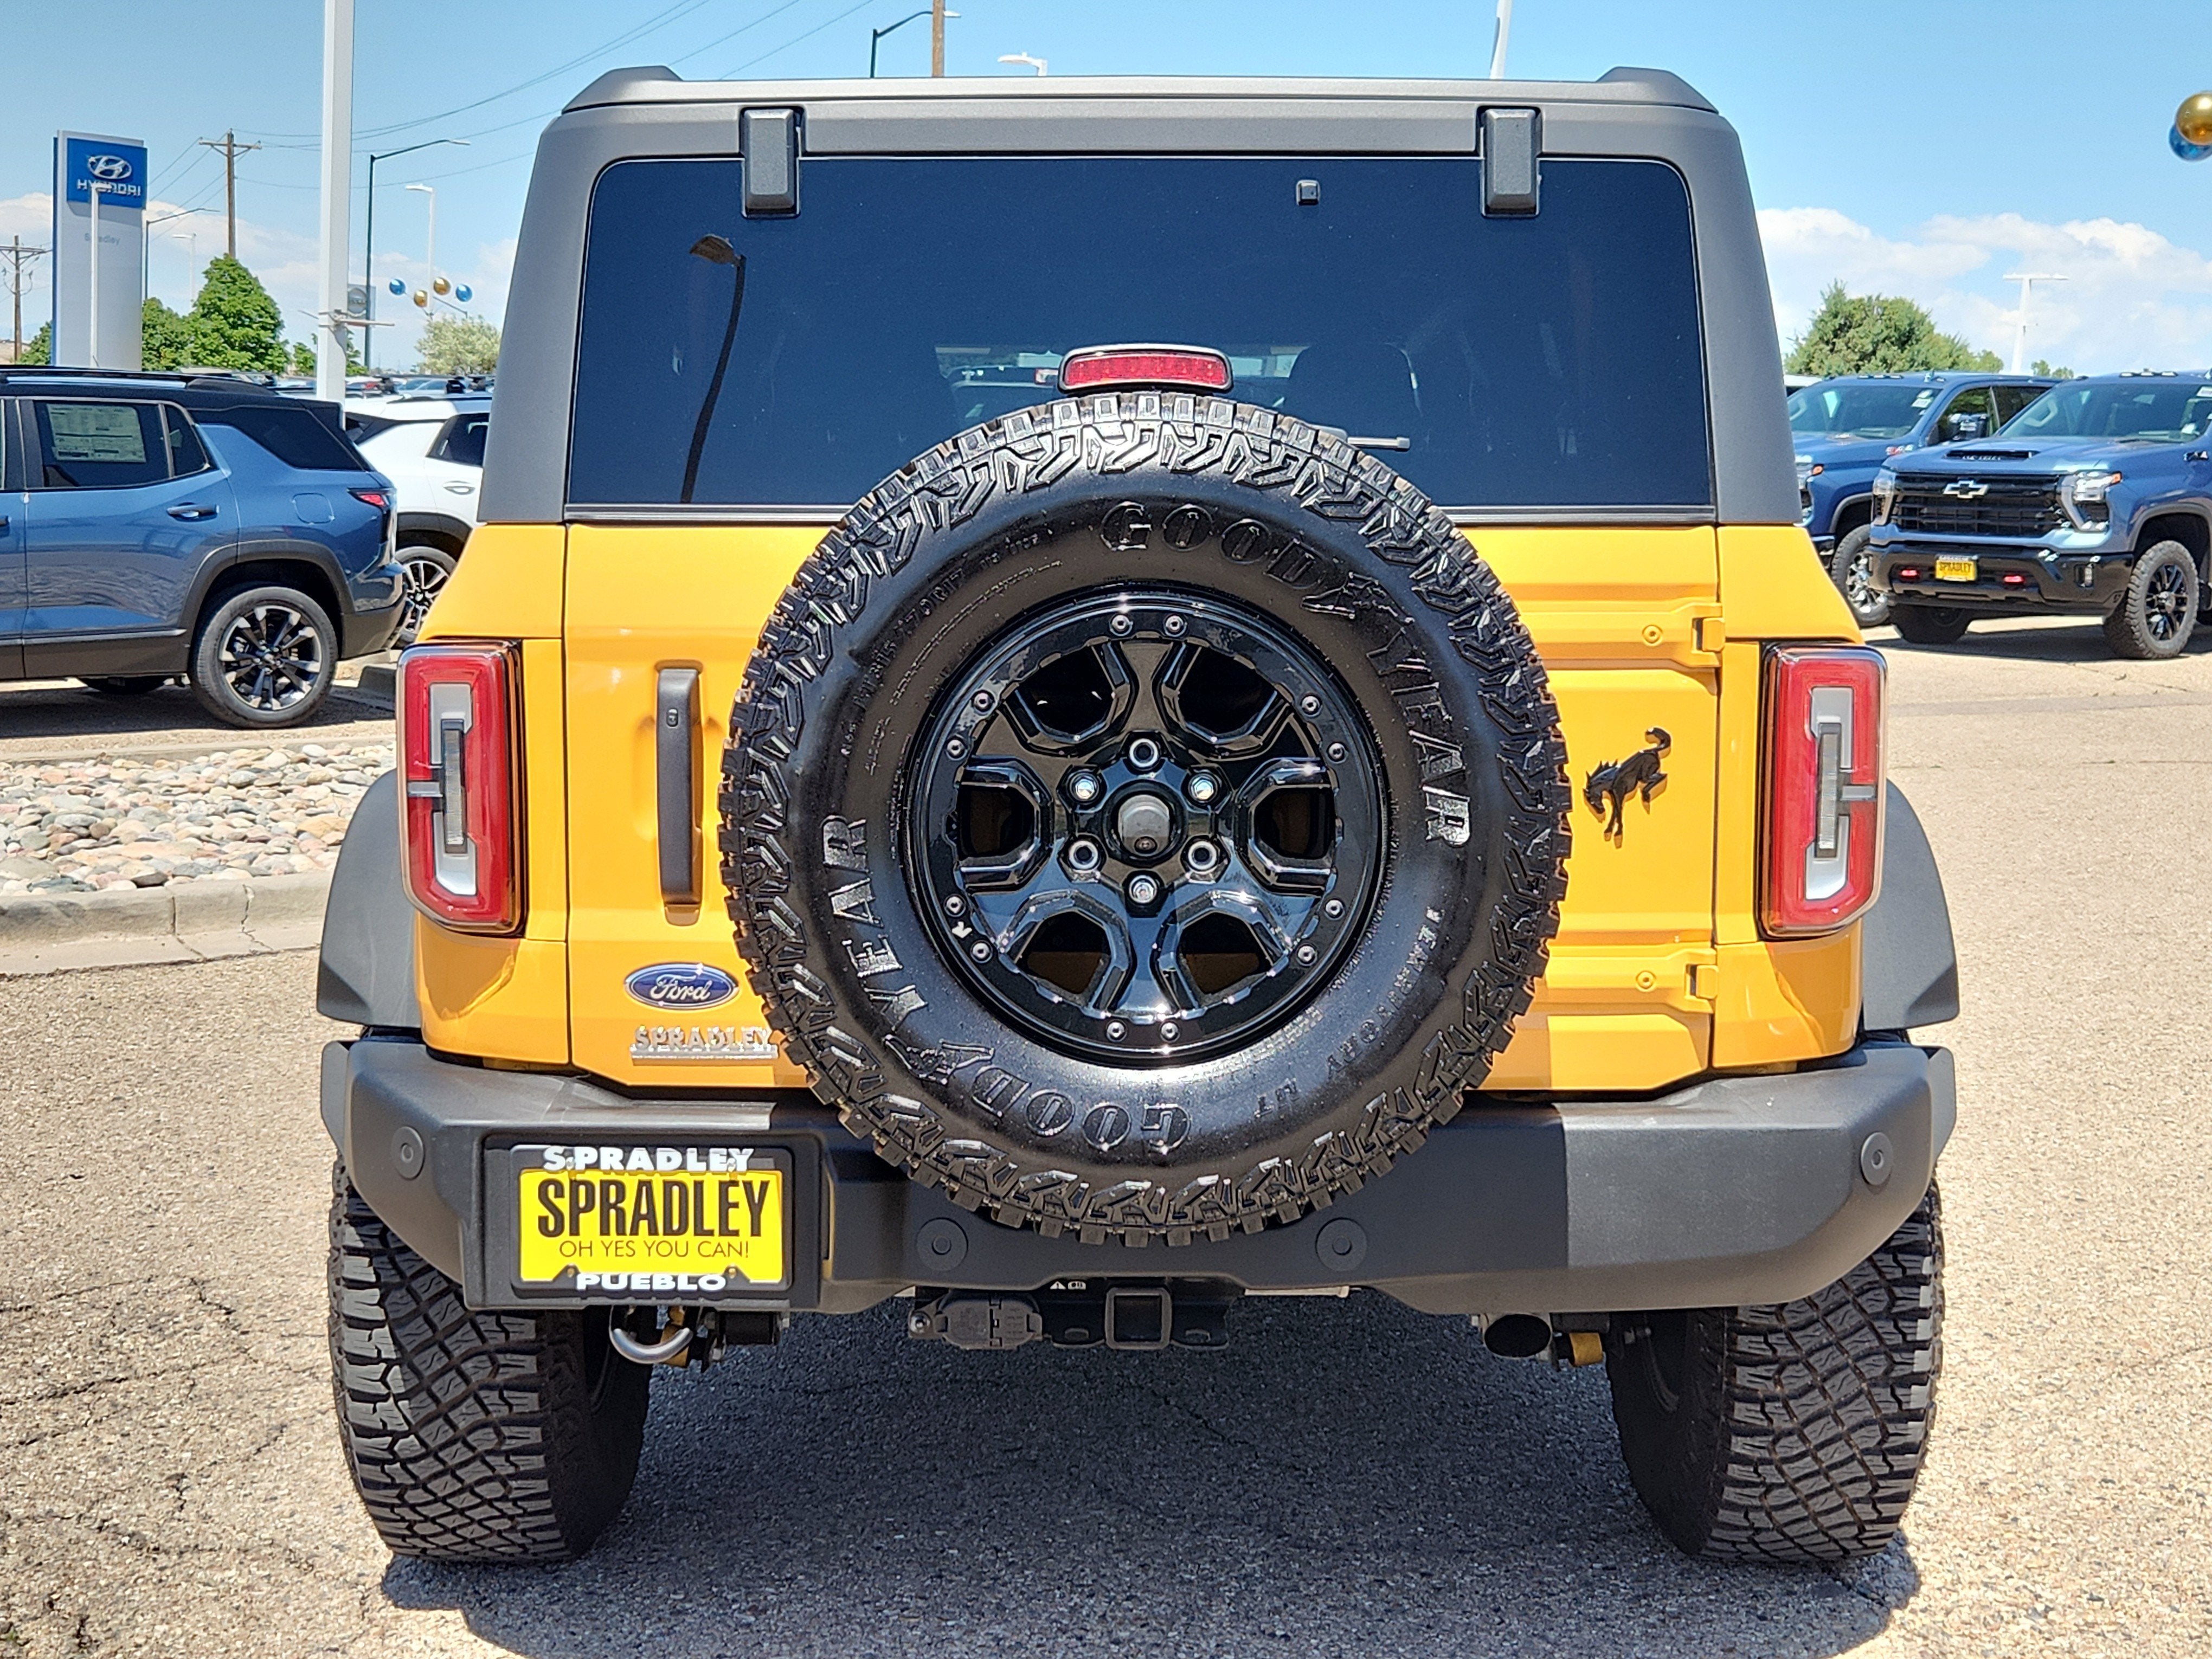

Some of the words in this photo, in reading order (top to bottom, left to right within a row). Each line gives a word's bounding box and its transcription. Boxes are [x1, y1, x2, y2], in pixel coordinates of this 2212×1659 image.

[84, 232, 121, 246] Sadley
[650, 974, 711, 1002] Ford
[634, 1026, 772, 1052] SPRADLEY
[543, 1147, 754, 1172] SPRADLEY
[537, 1179, 770, 1237] SPRADLEY
[559, 1240, 593, 1258] OH
[600, 1240, 636, 1258] YES
[642, 1240, 689, 1258] YOU
[697, 1240, 749, 1258] CAN!
[576, 1273, 726, 1291] PUEBLO
